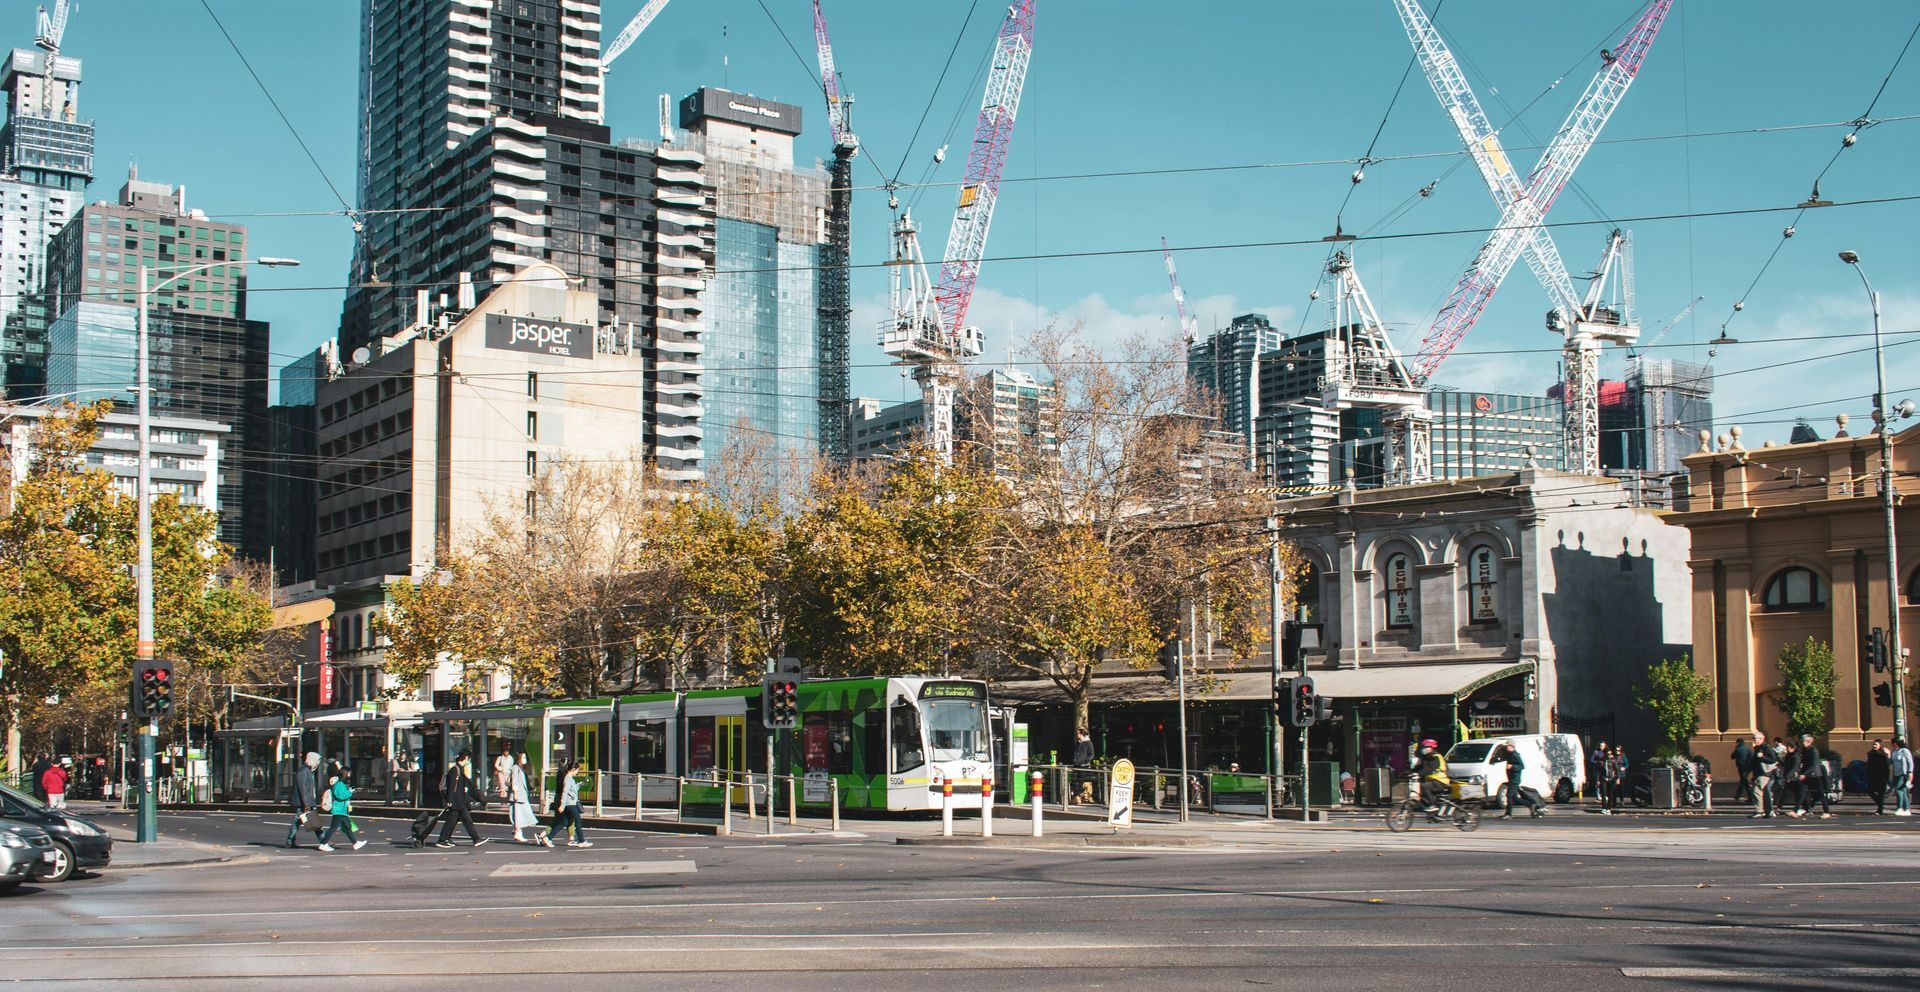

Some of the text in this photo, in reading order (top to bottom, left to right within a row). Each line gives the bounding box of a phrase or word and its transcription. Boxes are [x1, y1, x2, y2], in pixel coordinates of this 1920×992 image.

[728, 101, 780, 119] Queens Place
[509, 318, 572, 348] jasper.
[549, 345, 571, 356] HOTEL
[1395, 570, 1408, 614] CHEMIST
[1478, 563, 1492, 609] CHEMIST
[1474, 717, 1522, 729] CHEMIST
[890, 777, 905, 785] 5006
